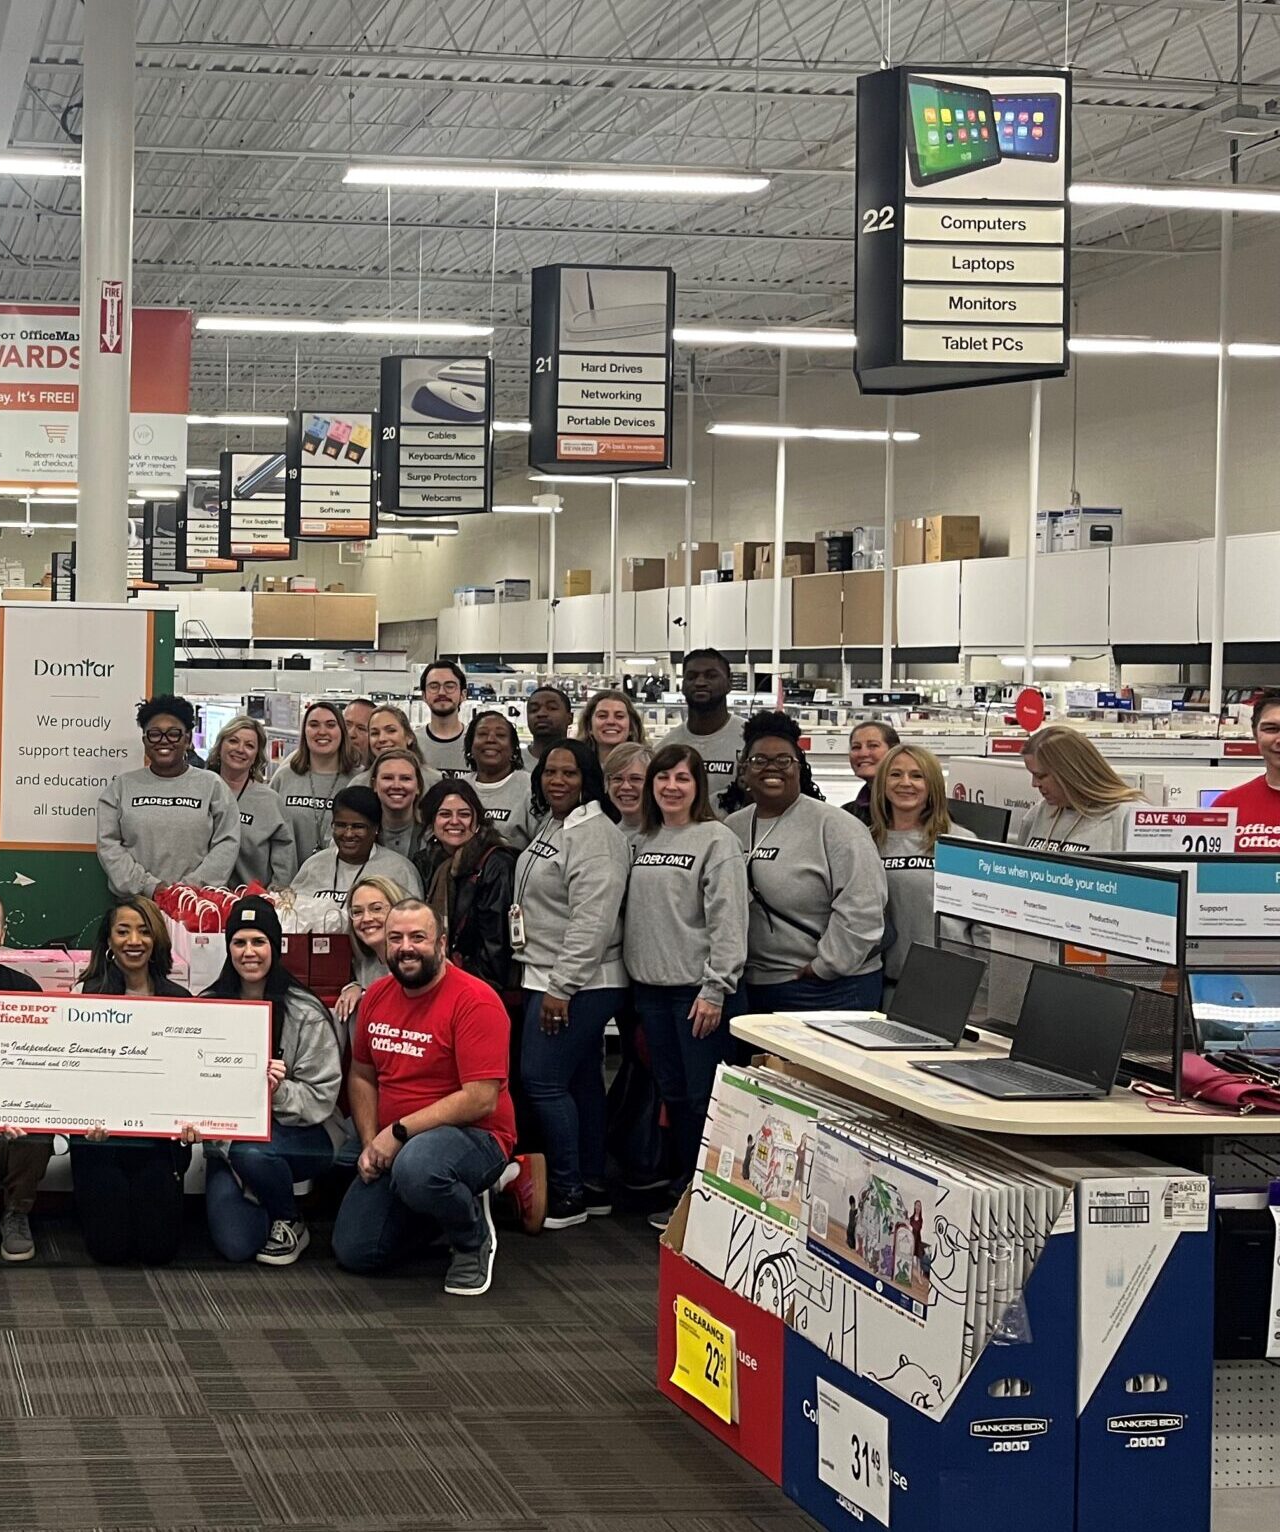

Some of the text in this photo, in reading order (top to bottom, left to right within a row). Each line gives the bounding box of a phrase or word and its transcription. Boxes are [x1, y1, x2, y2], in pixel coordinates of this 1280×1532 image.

[862, 205, 895, 234] 22
[940, 215, 1026, 233] Computers
[952, 256, 1015, 273] Laptops
[105, 287, 120, 298] FIRE
[949, 296, 1017, 311] Monitors
[942, 336, 1024, 351] Tablet PCs
[535, 356, 552, 373] 21
[581, 362, 643, 374] Hard Drives
[17, 391, 35, 403] It's
[39, 391, 75, 403] FREE!
[581, 389, 642, 402] Networking
[567, 415, 656, 427] Portable Devices
[382, 426, 396, 440] 20
[427, 431, 457, 440] Cables
[24, 450, 54, 459] Redeem
[408, 452, 476, 461] Keyboards/Mice
[288, 469, 298, 479] 19
[407, 472, 477, 482] Surge Protectors
[421, 493, 462, 502] Webcams
[320, 506, 351, 514] Software
[34, 658, 115, 678] Domtar
[36, 714, 111, 731] We proudly
[18, 745, 129, 759] support teachers
[708, 762, 734, 774] ONLY
[15, 774, 108, 787] and education
[133, 797, 200, 808] LEADERS ONLY
[33, 804, 97, 817] all studen
[485, 810, 509, 819] ONLY
[1138, 813, 1169, 824] SAVE
[666, 855, 693, 868] ONLY
[978, 858, 1118, 895] Pay less when you bundle your tech!
[1199, 904, 1228, 913] Support
[1088, 912, 1120, 927] Productivity
[21, 1004, 57, 1013] DEPOT
[68, 1007, 133, 1024] Domtar
[367, 1022, 433, 1044] Office DEPOT
[11, 1040, 65, 1053] Independence
[69, 1042, 116, 1056] Elementary
[119, 1045, 149, 1056] School
[197, 1048, 204, 1060] $
[371, 1037, 426, 1058] OfficeMax
[1, 1100, 22, 1108] School
[24, 1101, 52, 1111] Supplies
[683, 1307, 725, 1345] CLEARANCE
[973, 1421, 1045, 1433] BANKERS BOX
[1110, 1417, 1181, 1430] BANKERS BOX
